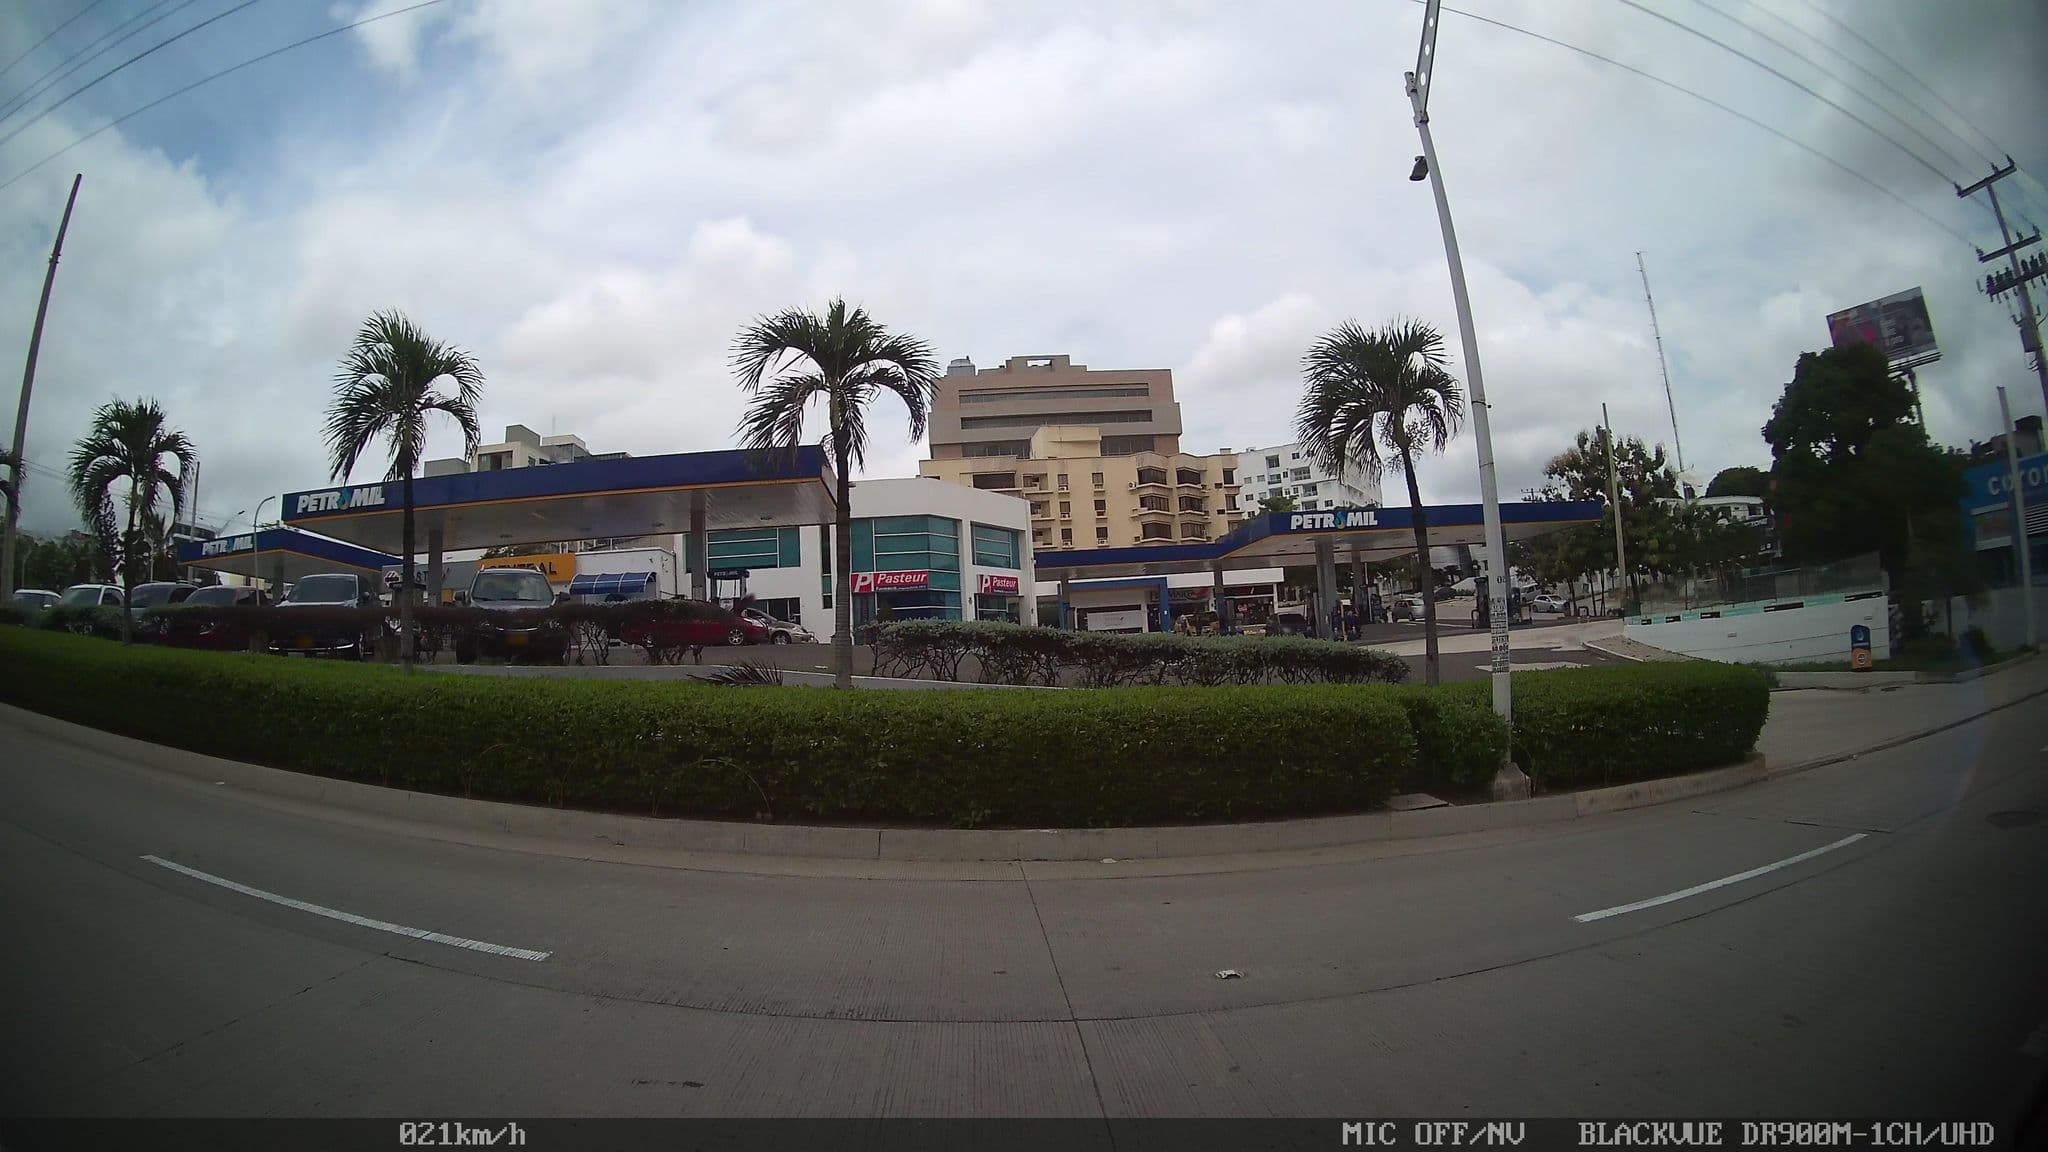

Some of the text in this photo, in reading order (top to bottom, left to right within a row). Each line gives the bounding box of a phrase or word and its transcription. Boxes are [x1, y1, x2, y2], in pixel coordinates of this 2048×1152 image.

[296, 486, 385, 513] PETROMIL
[1290, 511, 1378, 530] PETROMIL
[877, 572, 927, 584] Pasteur
[992, 576, 1017, 589] Pasteur
